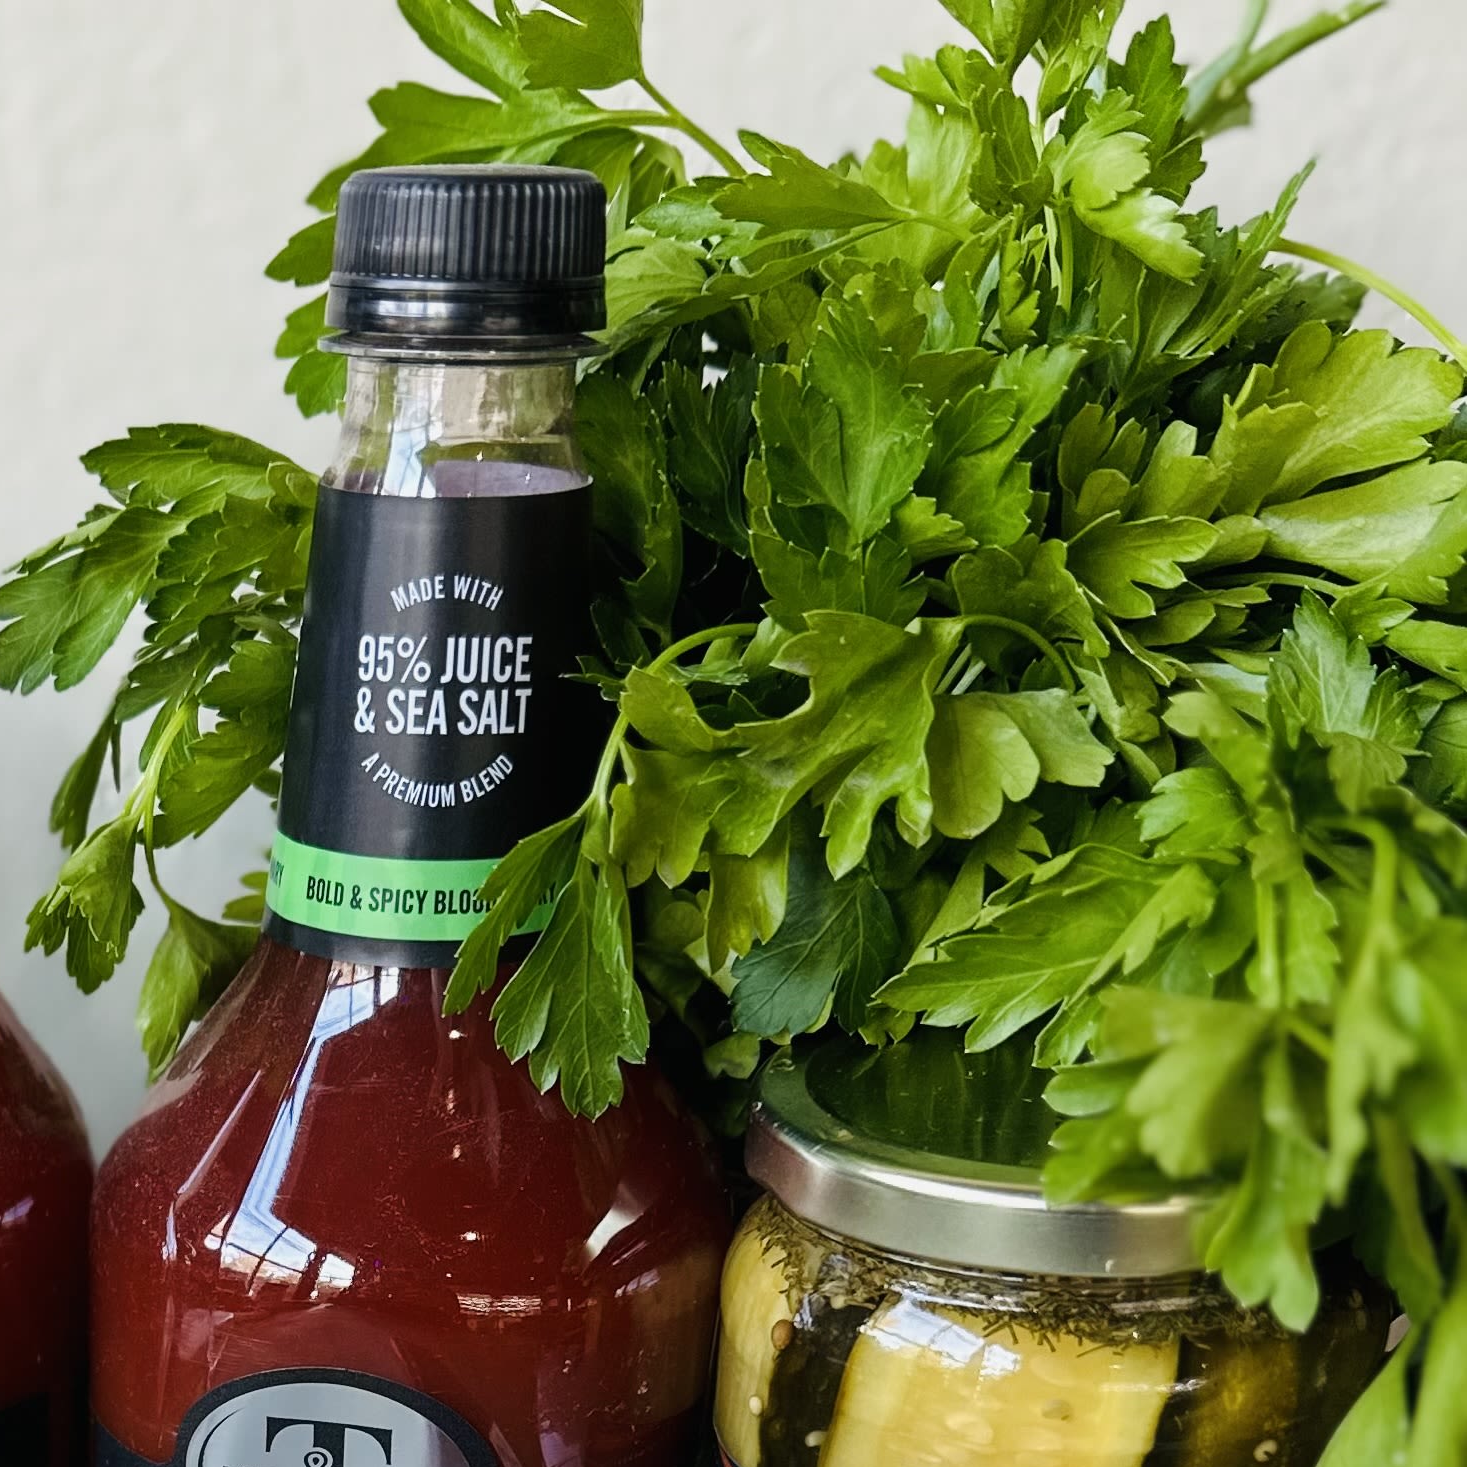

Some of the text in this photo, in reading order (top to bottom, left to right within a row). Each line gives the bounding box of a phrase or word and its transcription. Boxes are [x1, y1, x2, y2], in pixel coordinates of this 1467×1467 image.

[390, 575, 504, 613] MADE WITH
[358, 635, 532, 684] 95% JUICE
[354, 688, 532, 735] & SEA SALT
[360, 751, 514, 808] A PREMIUM BLEND
[306, 875, 344, 907] BOLD
[350, 885, 362, 910] &
[368, 887, 428, 915] SPICY
